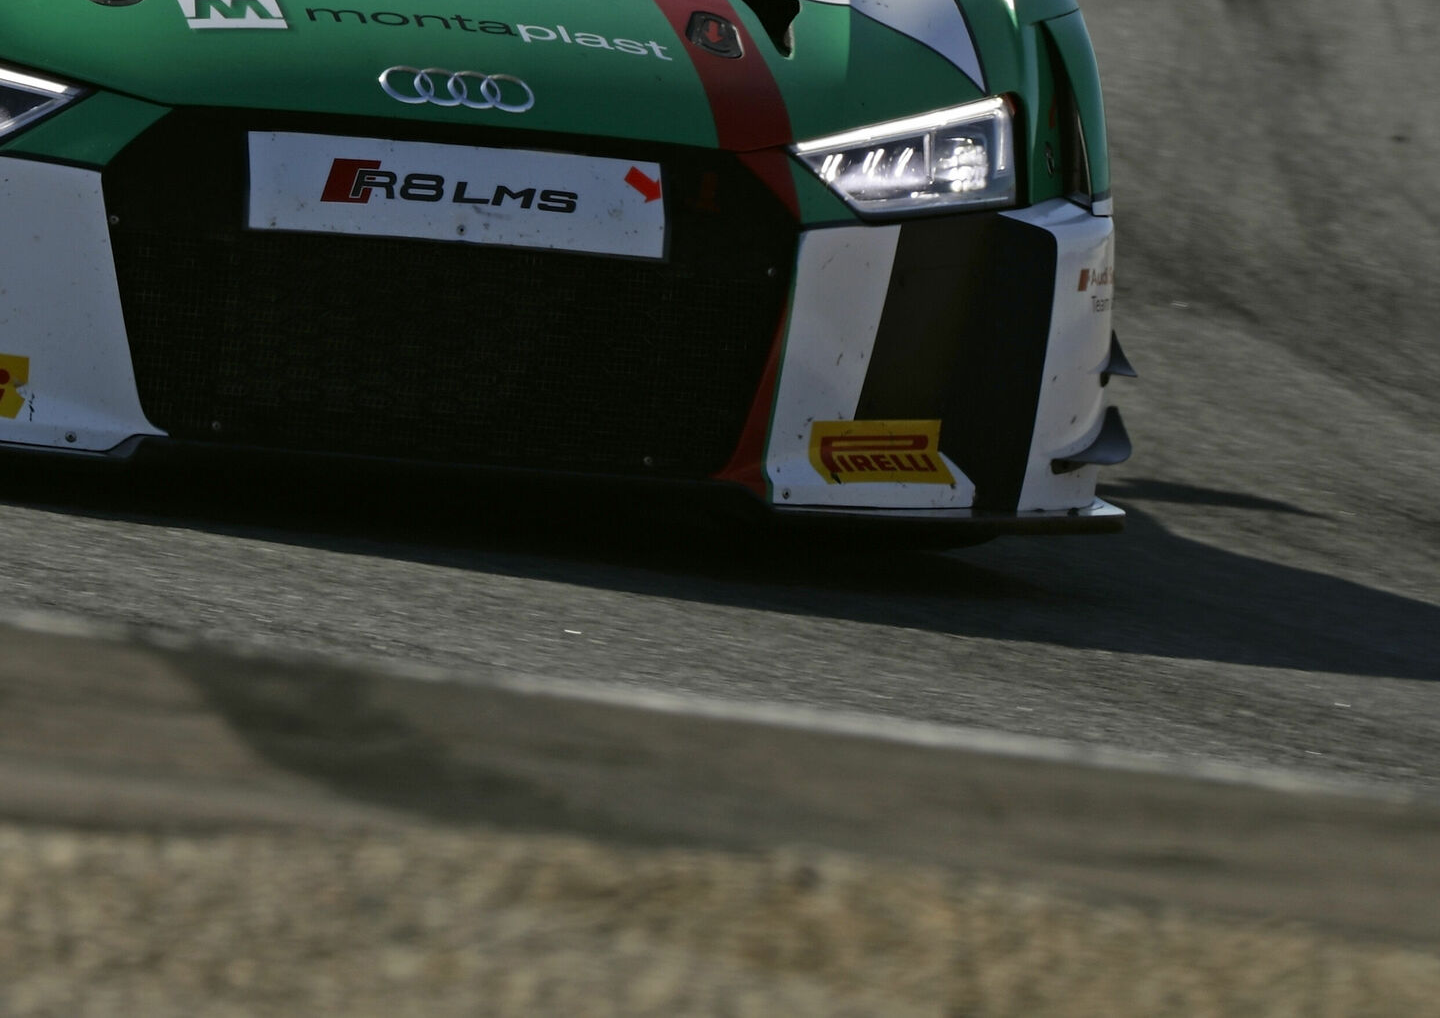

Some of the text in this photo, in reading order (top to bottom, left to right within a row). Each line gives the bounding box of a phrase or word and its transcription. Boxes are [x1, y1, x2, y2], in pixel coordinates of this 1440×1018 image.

[305, 5, 673, 61] montaplast
[353, 168, 578, 214] R8 LMS
[820, 435, 938, 473] PIRELLI
